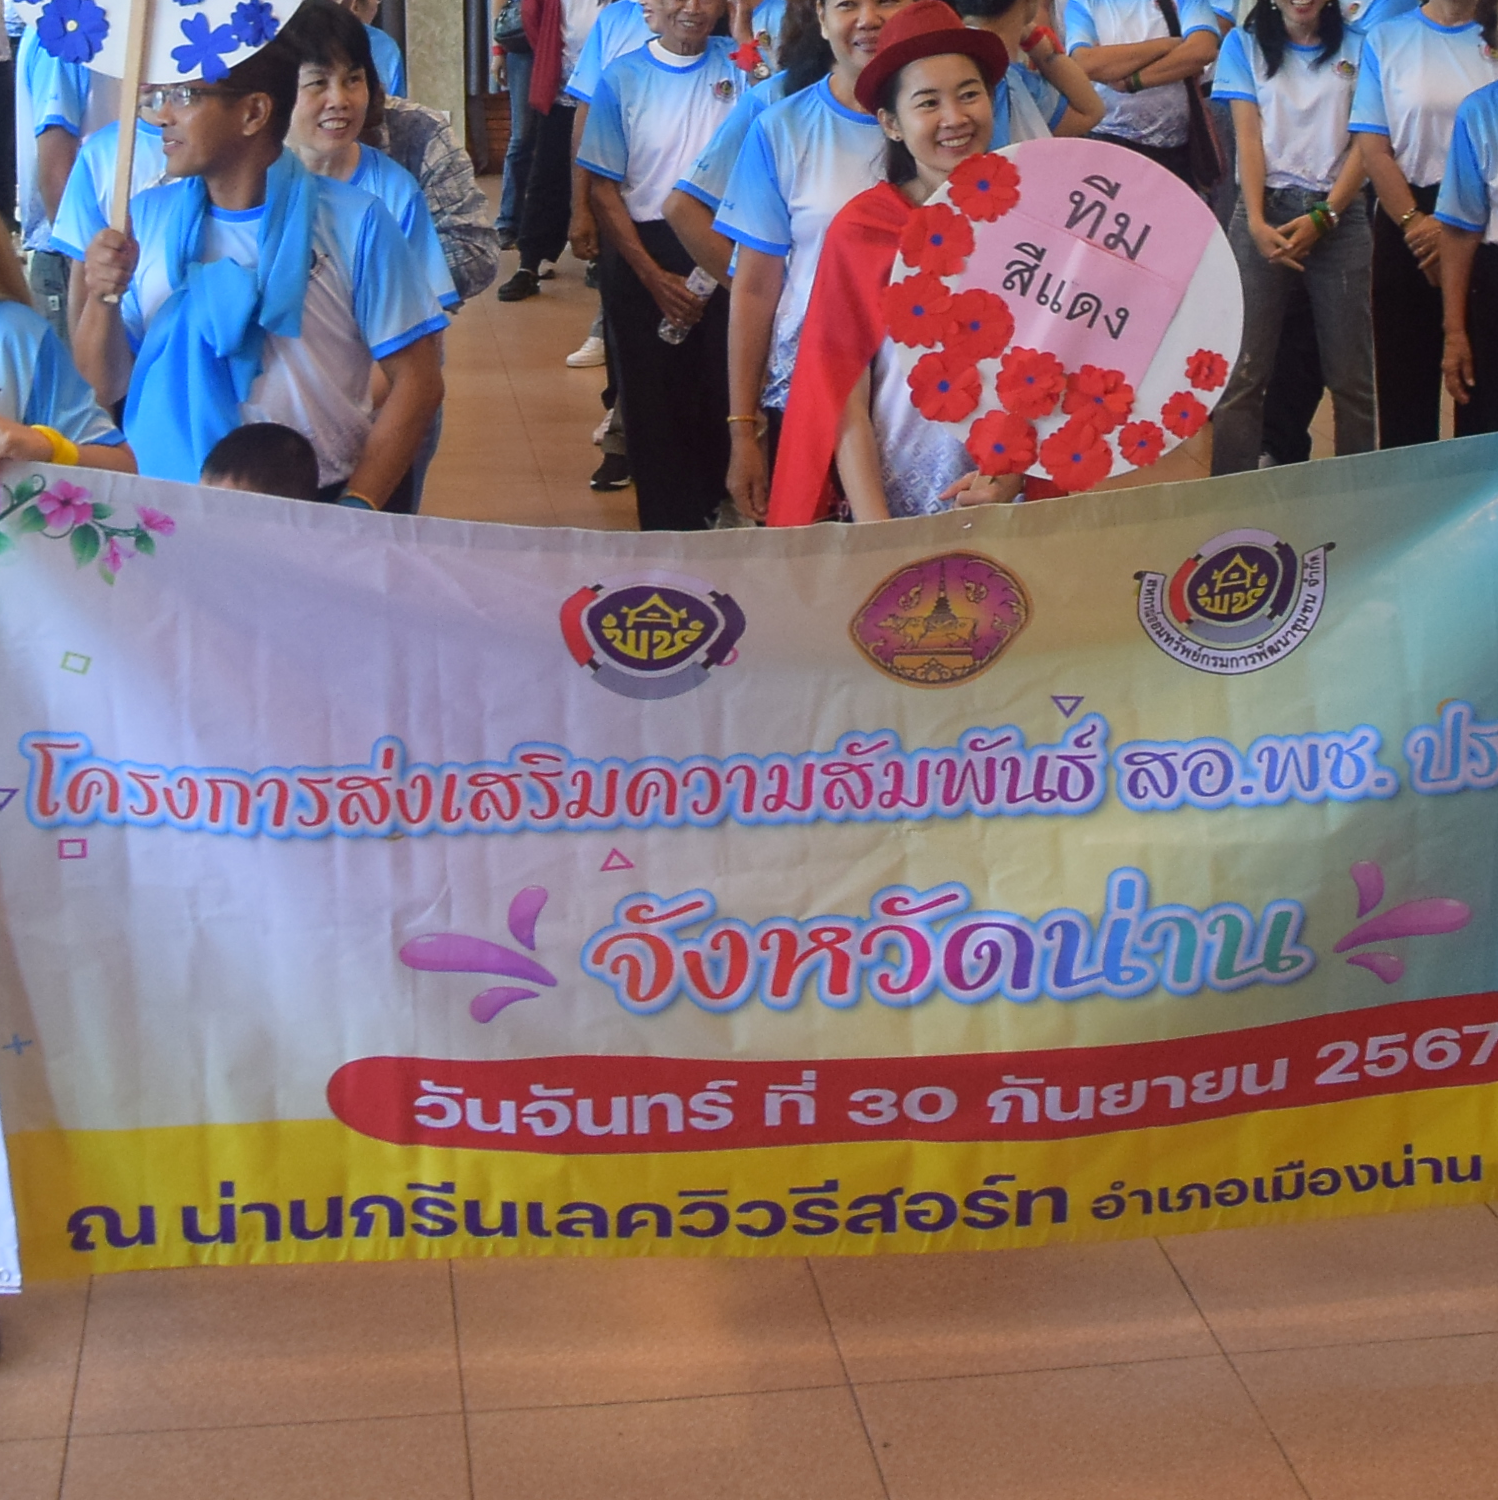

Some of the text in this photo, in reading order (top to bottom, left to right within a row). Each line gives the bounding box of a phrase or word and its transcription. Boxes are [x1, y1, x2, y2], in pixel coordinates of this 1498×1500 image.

[1064, 174, 1152, 261] ทีม
[1002, 241, 1130, 340] สีแดง
[30, 723, 1099, 829] โครงการส่งเสริมความสัมพันธ์
[1123, 734, 1388, 800] สอ.พช.
[591, 877, 1304, 1002] จังหวัดน่าน
[414, 1080, 738, 1136] วันจันทร์
[764, 1070, 817, 1126] ที่
[847, 1086, 959, 1125] 30
[986, 1057, 1290, 1124] กันยายน
[66, 1204, 157, 1252] ณ
[181, 1173, 1069, 1245] น่านกรีนเลควิวรีสอร์ท
[1090, 1143, 1483, 1221] อำเภอเมืองน่าน
